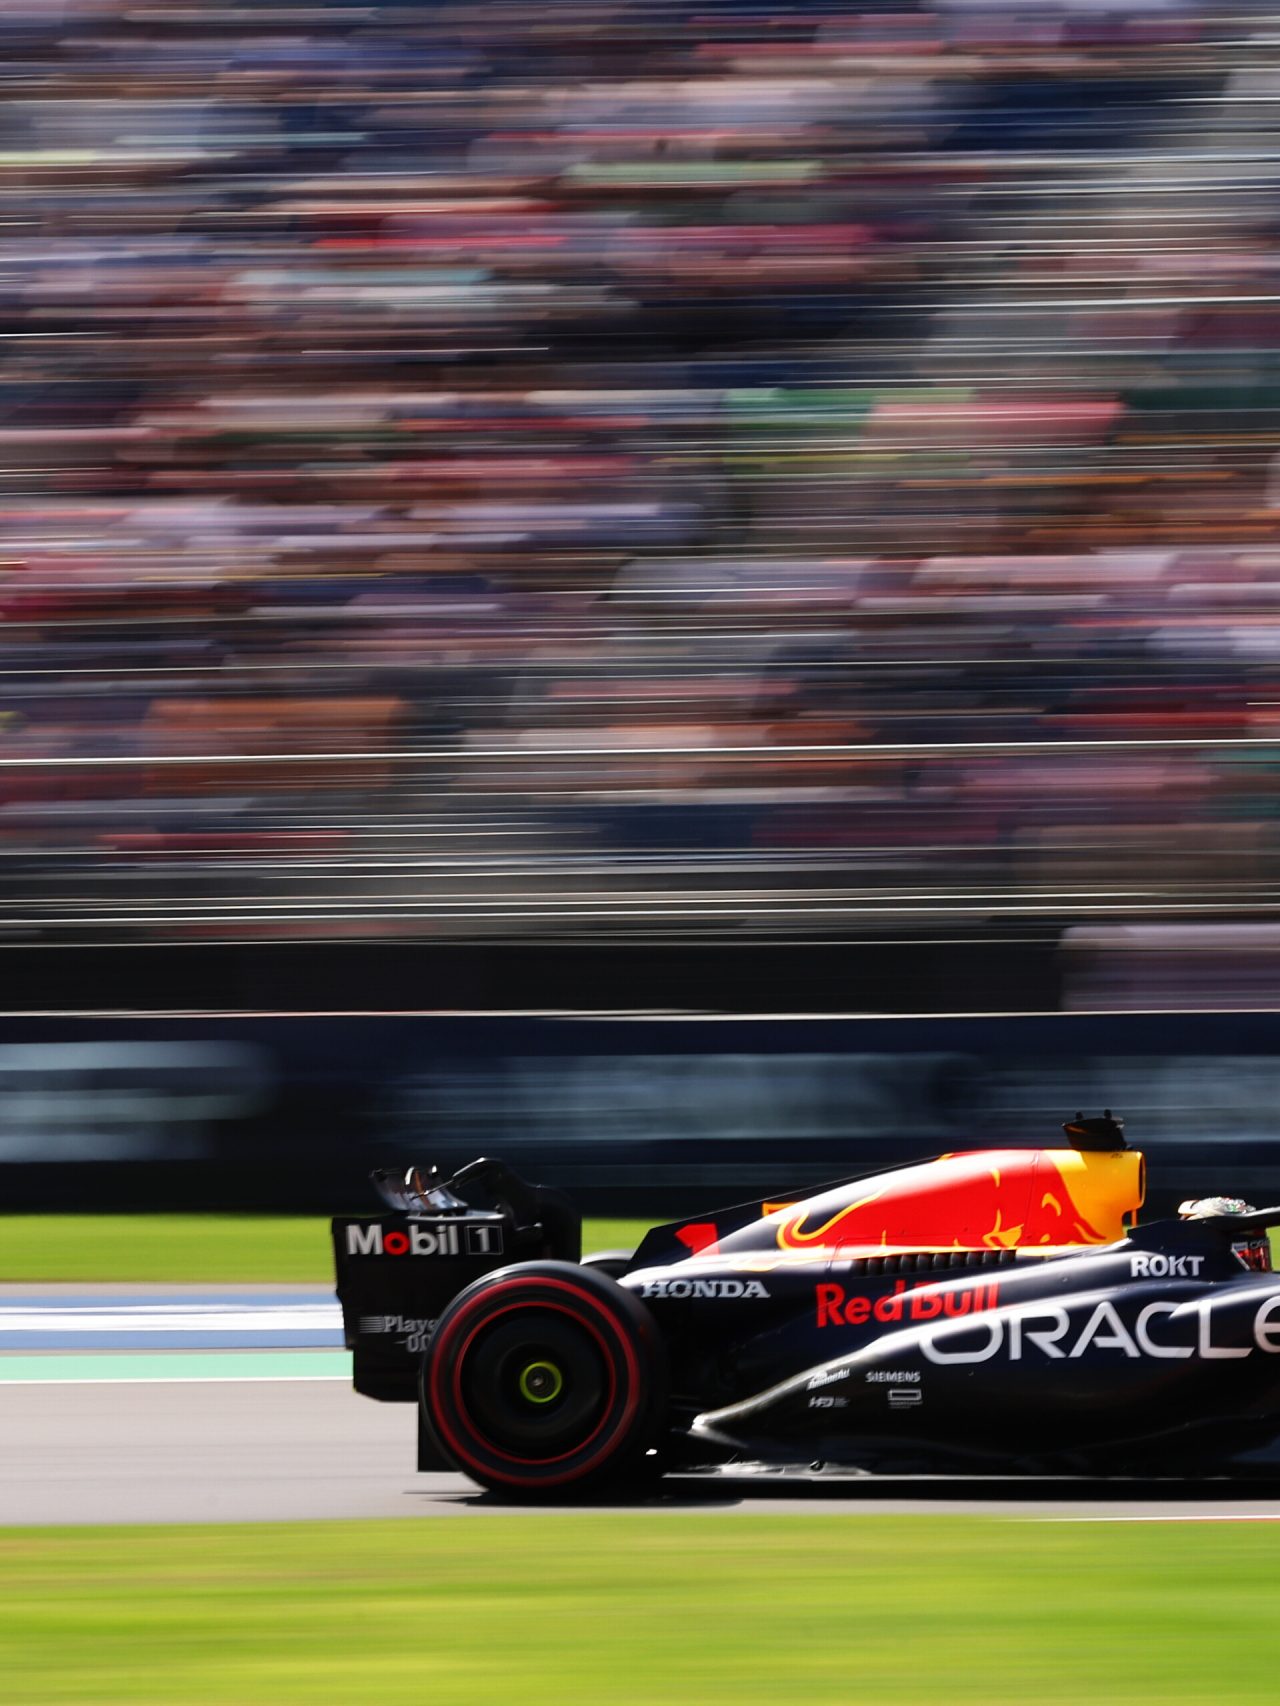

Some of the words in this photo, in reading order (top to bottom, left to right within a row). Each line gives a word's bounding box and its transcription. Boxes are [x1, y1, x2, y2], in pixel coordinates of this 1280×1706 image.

[346, 1225, 459, 1255] Mobil
[475, 1227, 490, 1253] 1
[1130, 1256, 1205, 1278] ROKT
[641, 1280, 771, 1298] HONDA
[865, 1370, 921, 1383] SIEMENS
